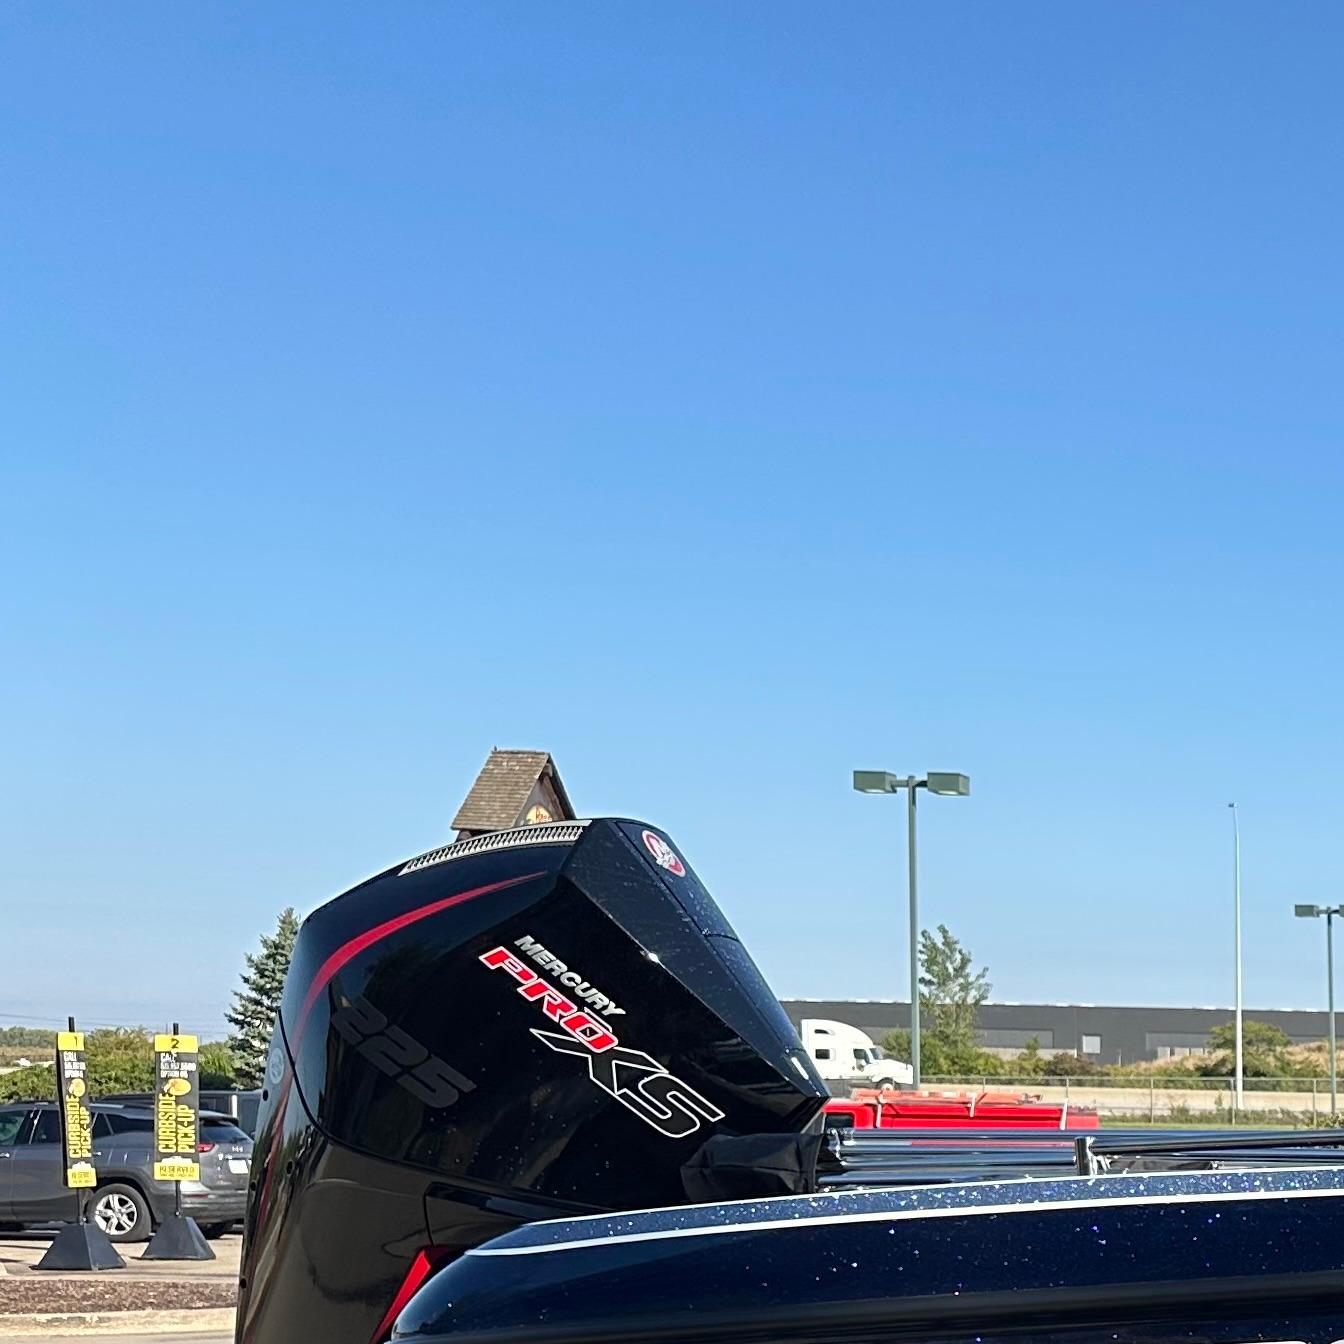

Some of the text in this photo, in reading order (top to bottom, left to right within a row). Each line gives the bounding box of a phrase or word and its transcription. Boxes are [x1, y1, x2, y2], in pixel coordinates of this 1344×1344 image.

[514, 935, 626, 1016] MERCURY
[170, 1038, 180, 1049] 2
[331, 994, 477, 1109] 225
[478, 946, 725, 1138] PRO XS
[65, 1094, 82, 1158] CURBSIDE
[80, 1106, 92, 1158] PICK-UP
[158, 1093, 177, 1153] CURBSIDE
[177, 1104, 195, 1153] PICK-UP
